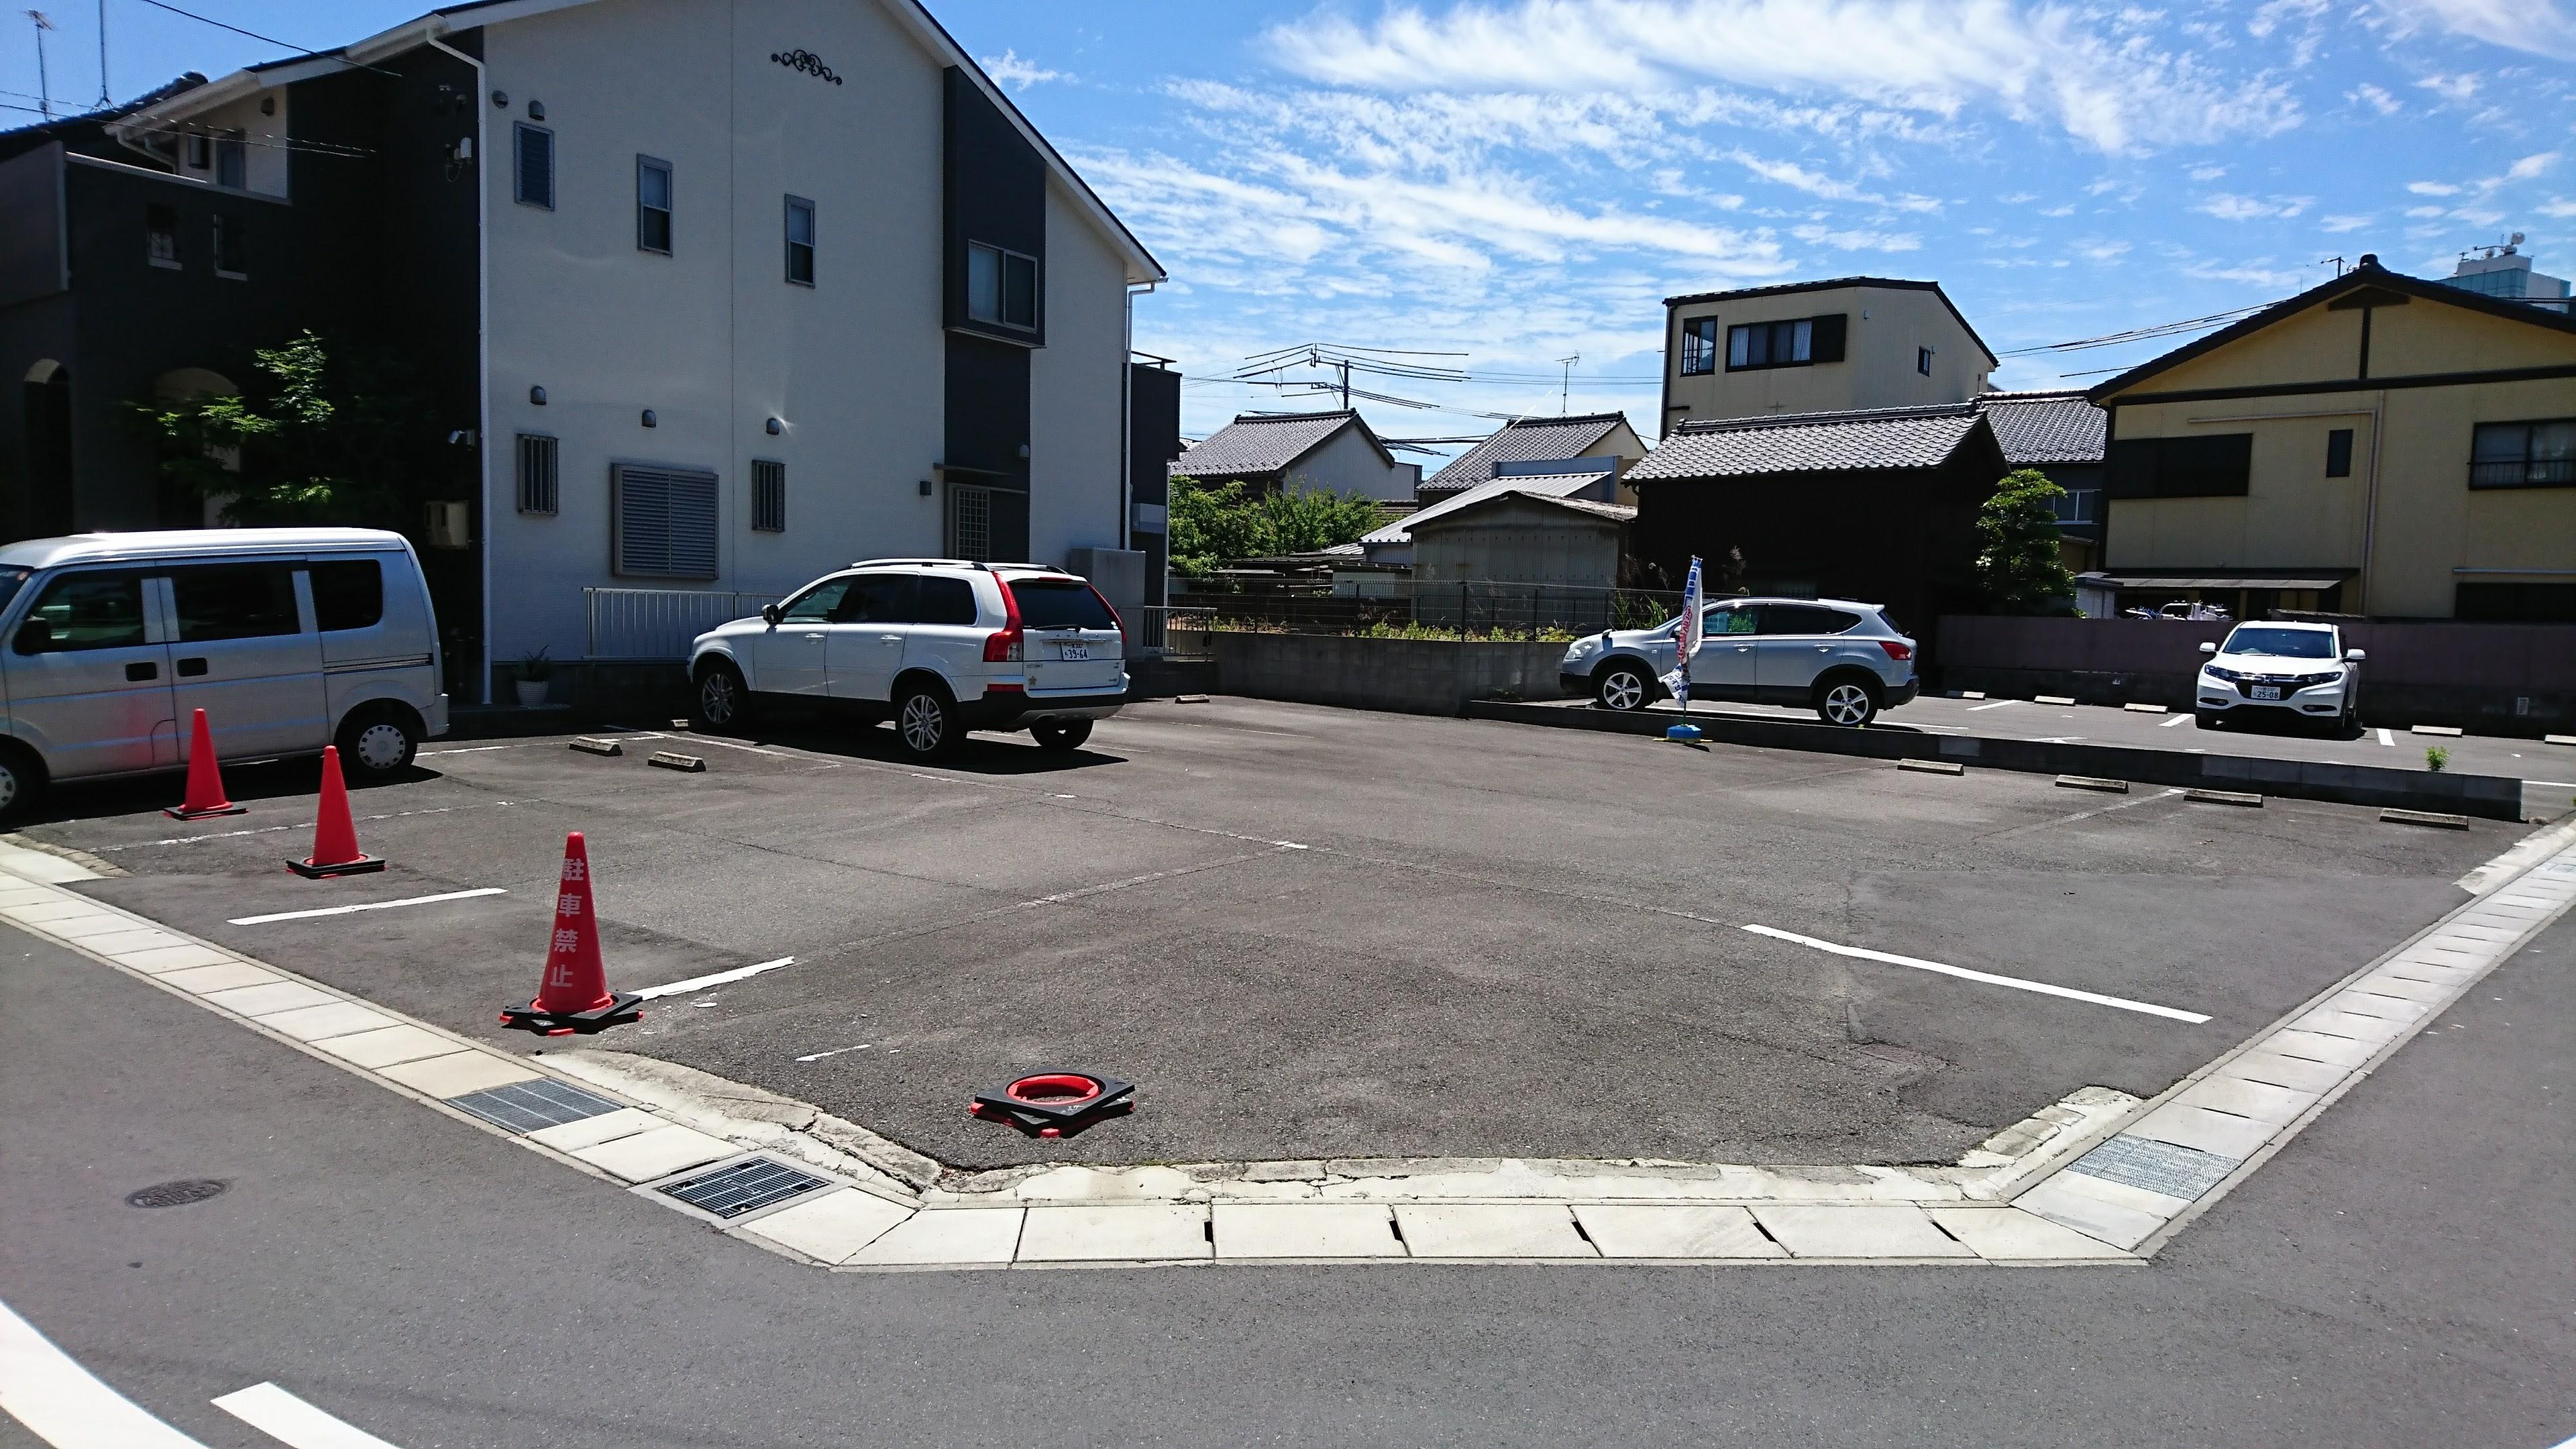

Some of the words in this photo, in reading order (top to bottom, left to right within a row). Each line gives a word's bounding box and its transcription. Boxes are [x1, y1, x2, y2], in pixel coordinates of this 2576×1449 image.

[1068, 649, 1088, 659] 39-64
[550, 858, 584, 987] 駐車禁止
